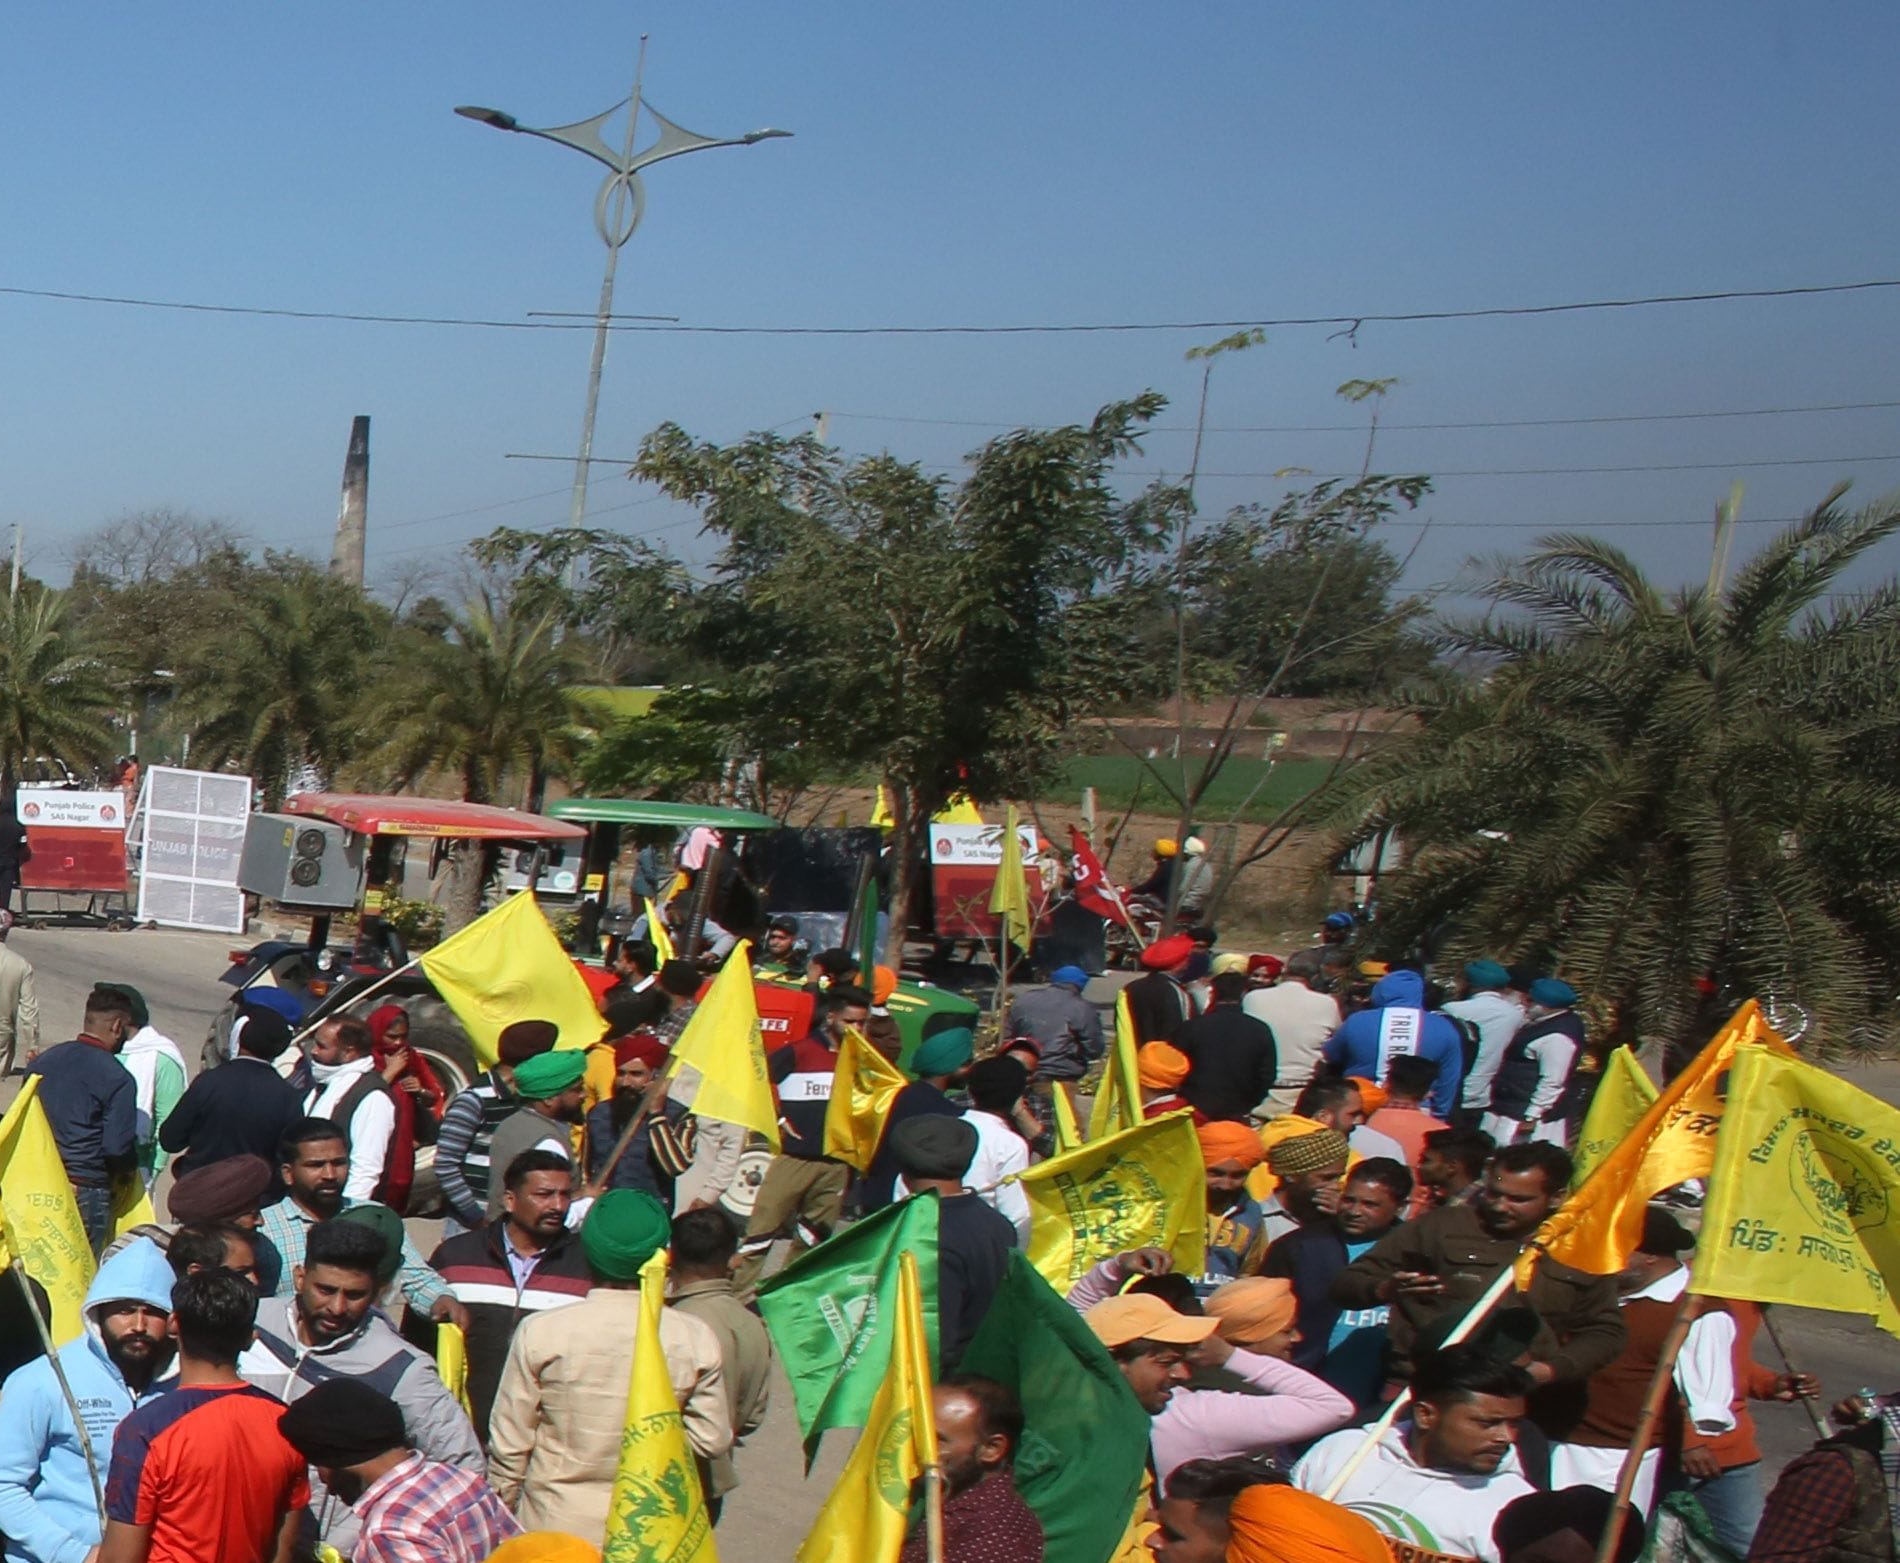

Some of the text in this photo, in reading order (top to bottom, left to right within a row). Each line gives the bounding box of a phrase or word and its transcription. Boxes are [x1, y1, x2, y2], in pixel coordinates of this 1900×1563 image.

[44, 800, 96, 813] Punjab Police
[50, 812, 90, 826] SAS Nagar
[1388, 1014, 1412, 1041] TRUE
[77, 1398, 113, 1411] Off-White
